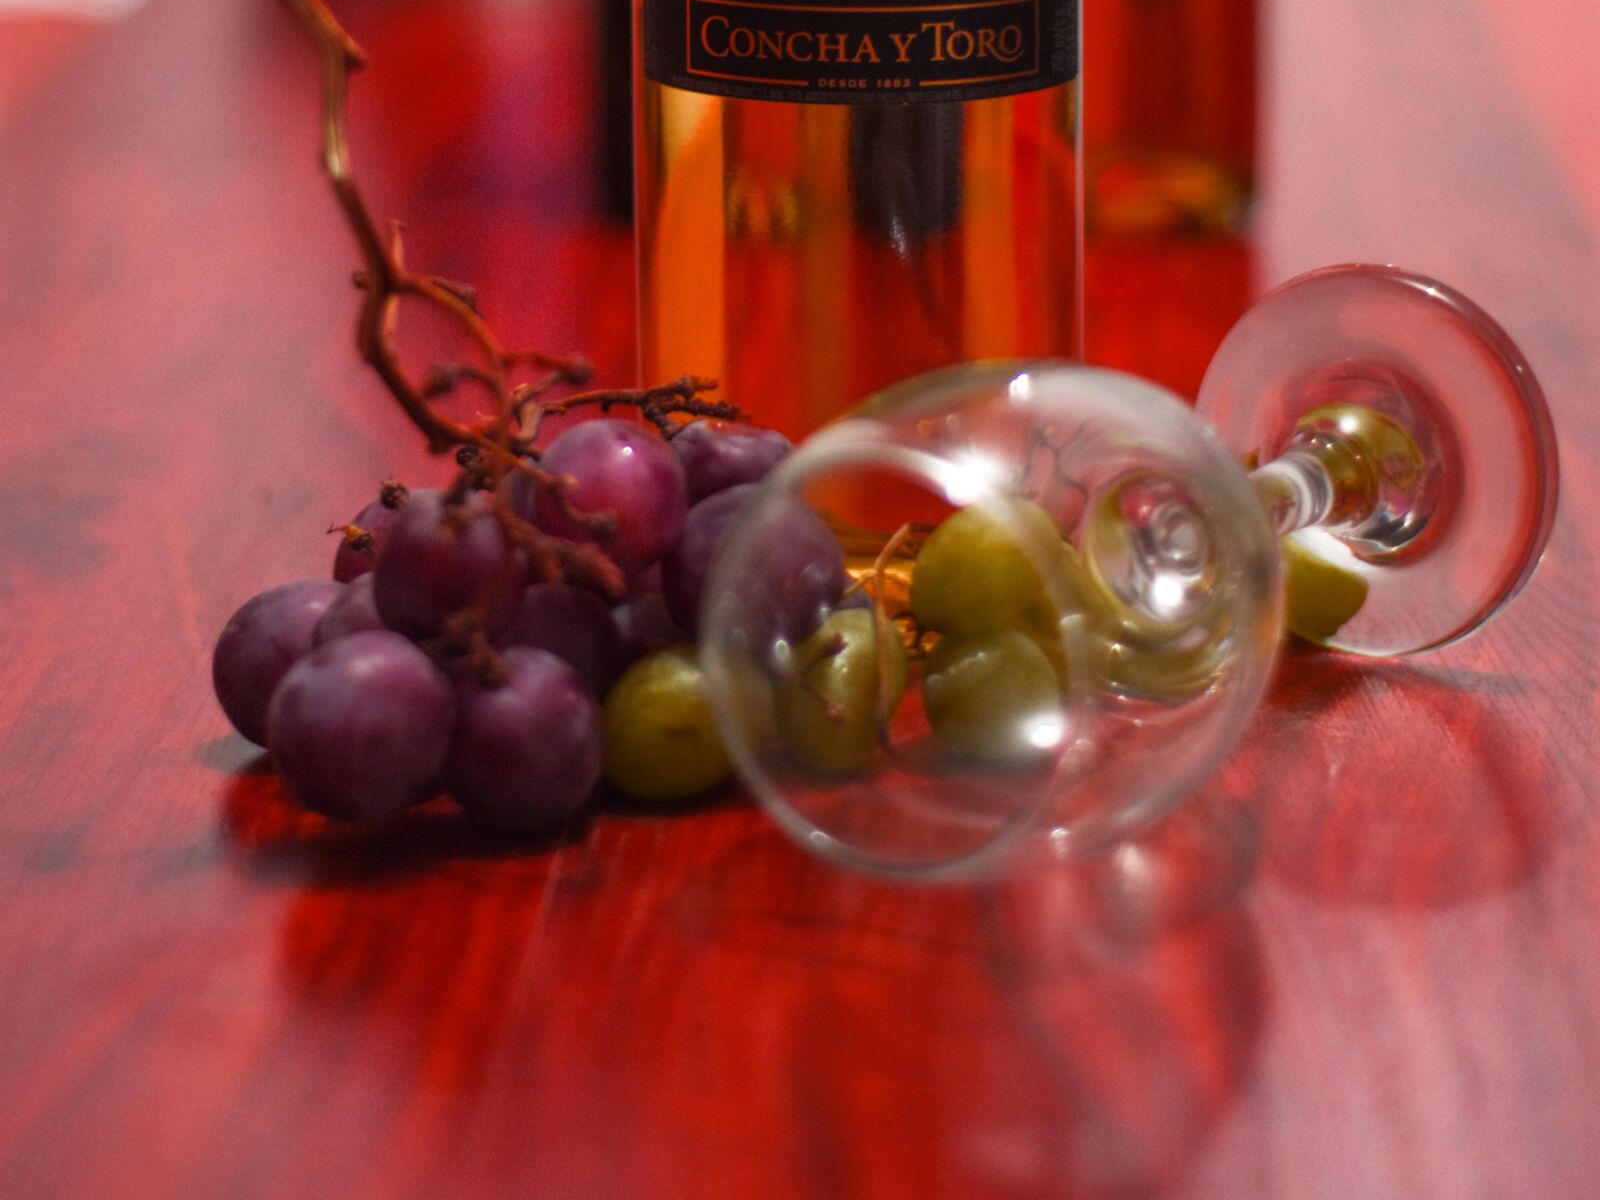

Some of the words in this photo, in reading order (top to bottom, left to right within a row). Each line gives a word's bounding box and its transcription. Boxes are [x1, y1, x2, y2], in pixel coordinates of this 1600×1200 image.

[700, 14, 881, 64] CONCHA
[890, 33, 918, 63] Y
[921, 20, 1025, 62] TORO
[817, 77, 868, 89] DESDE
